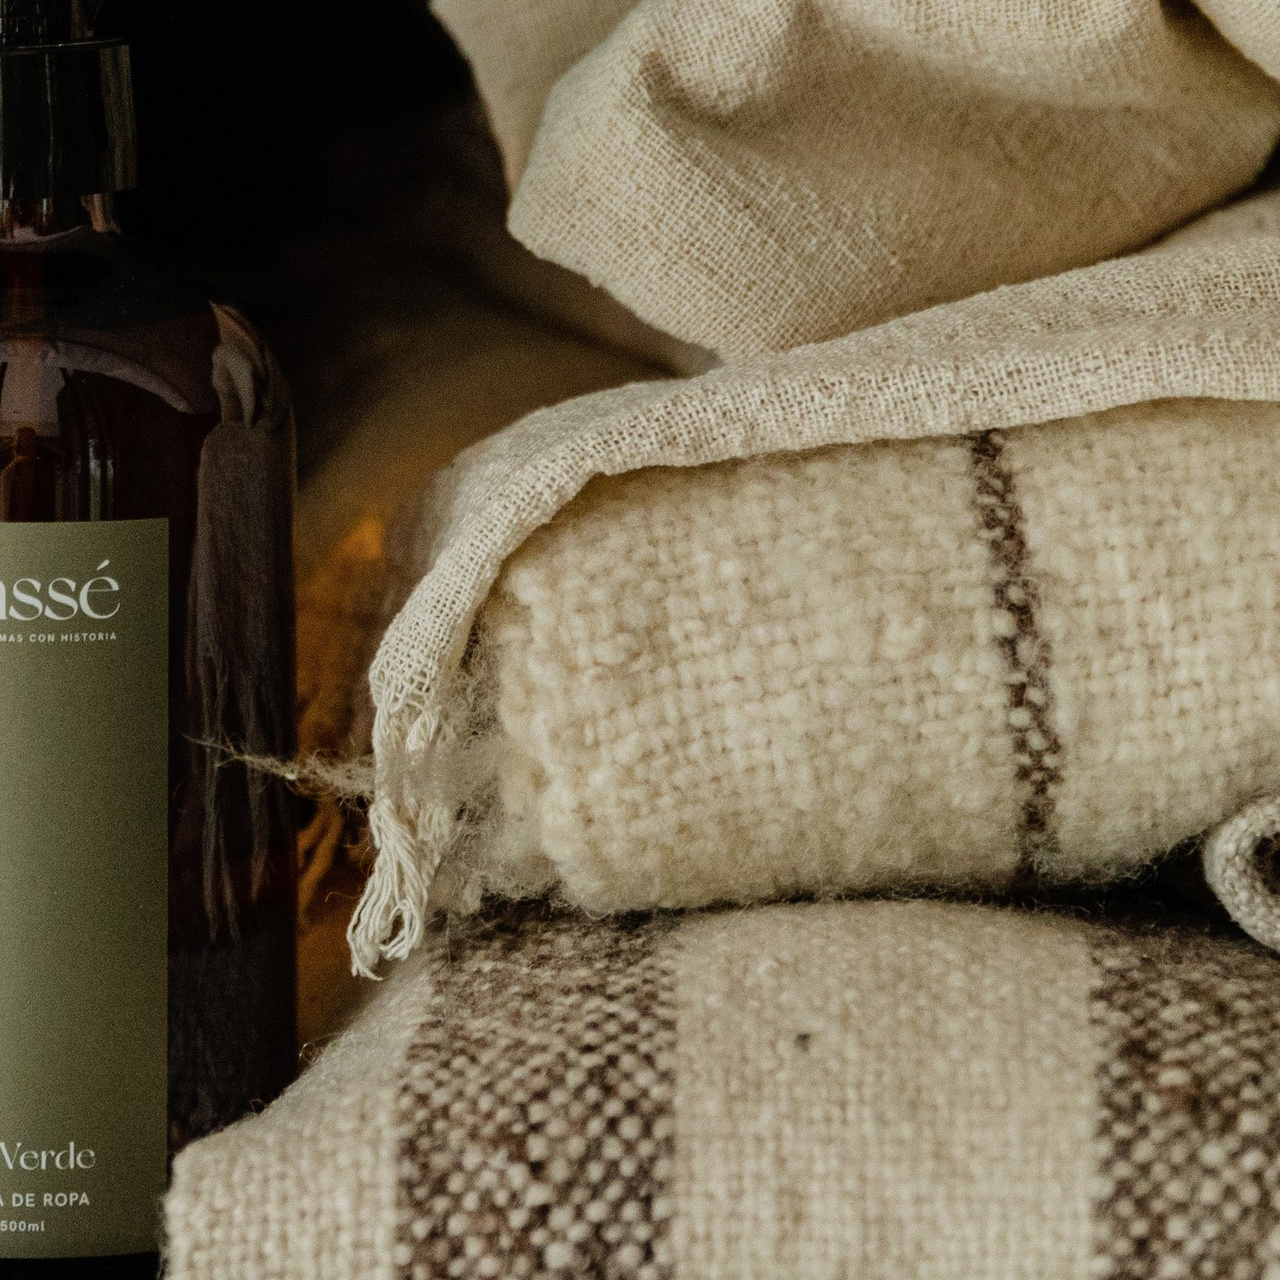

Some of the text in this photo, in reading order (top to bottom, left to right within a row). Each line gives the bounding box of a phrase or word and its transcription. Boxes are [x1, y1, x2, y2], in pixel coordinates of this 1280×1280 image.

[29, 633, 55, 643] CON
[61, 632, 117, 643] HISTORIA
[12, 1192, 35, 1207] DE
[43, 1192, 90, 1207] ROPA
[0, 1220, 45, 1232] 500ml
